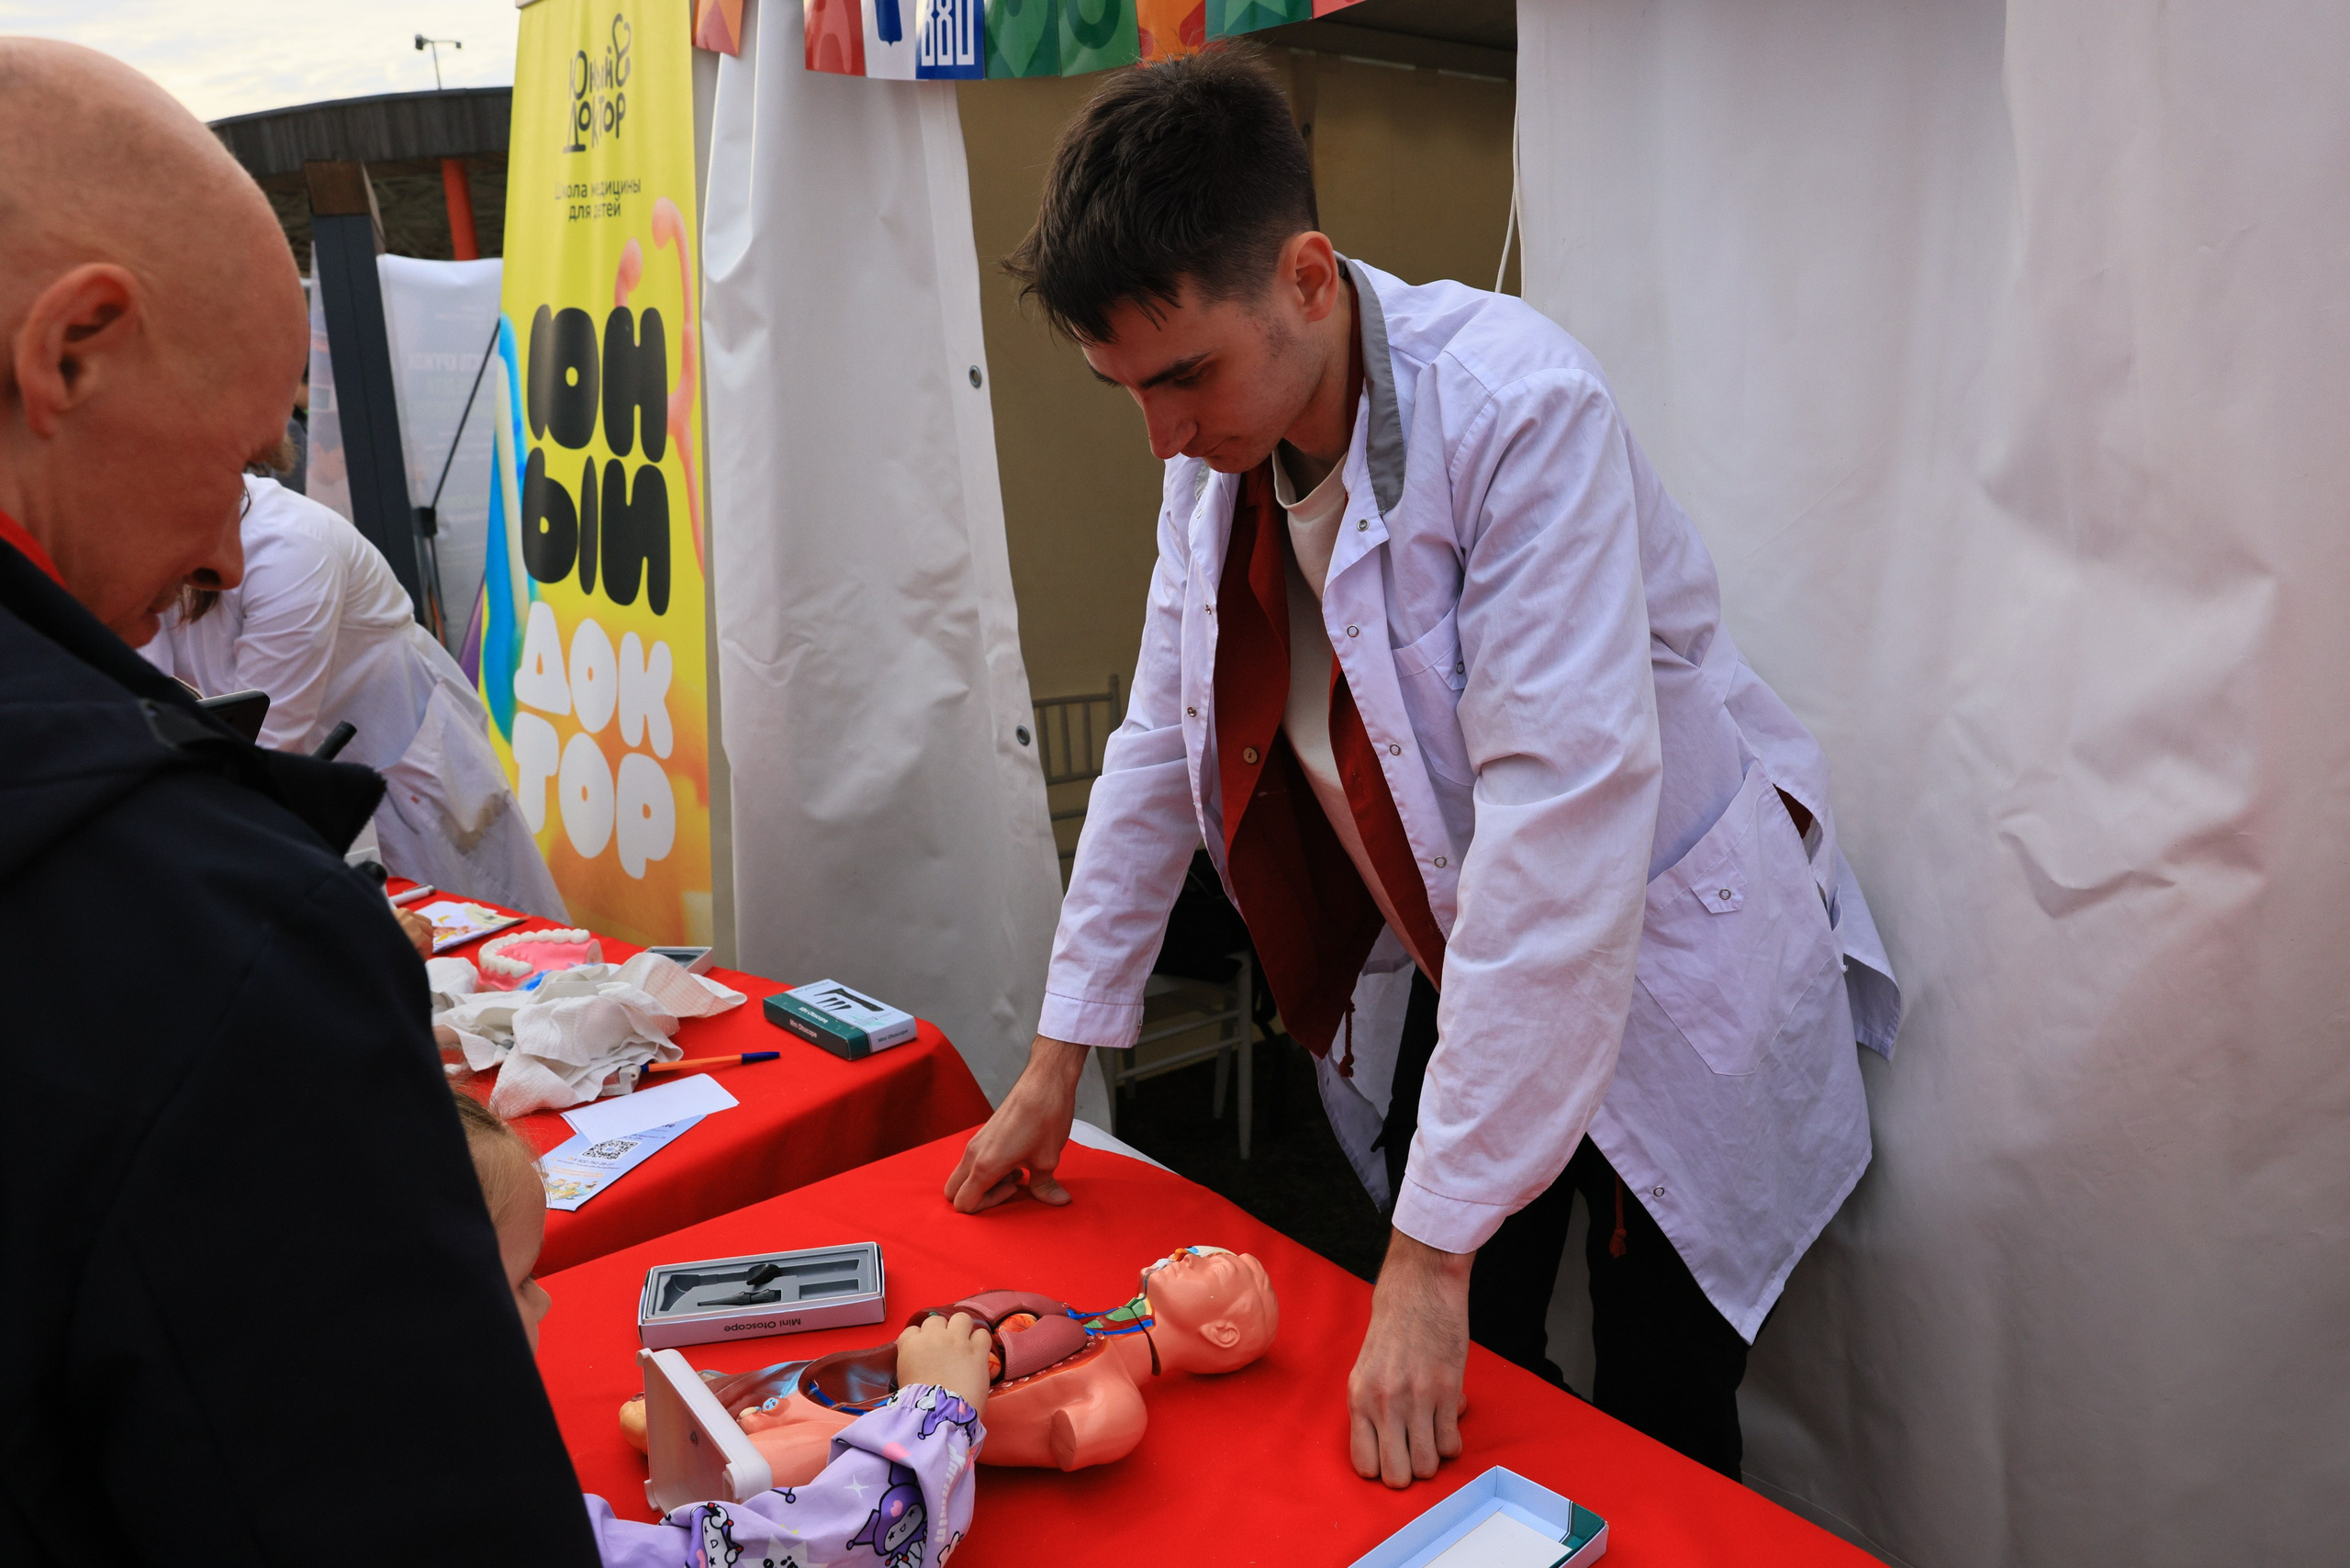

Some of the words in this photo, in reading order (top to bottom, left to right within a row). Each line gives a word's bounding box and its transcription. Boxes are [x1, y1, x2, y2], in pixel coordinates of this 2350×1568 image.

[568, 205, 591, 222] для
[527, 304, 668, 464] ЮН
[513, 601, 673, 759] ДОК
[511, 711, 677, 879] ТОР
[723, 1320, 777, 1332] Otoscope
[779, 1317, 801, 1327] Mini
